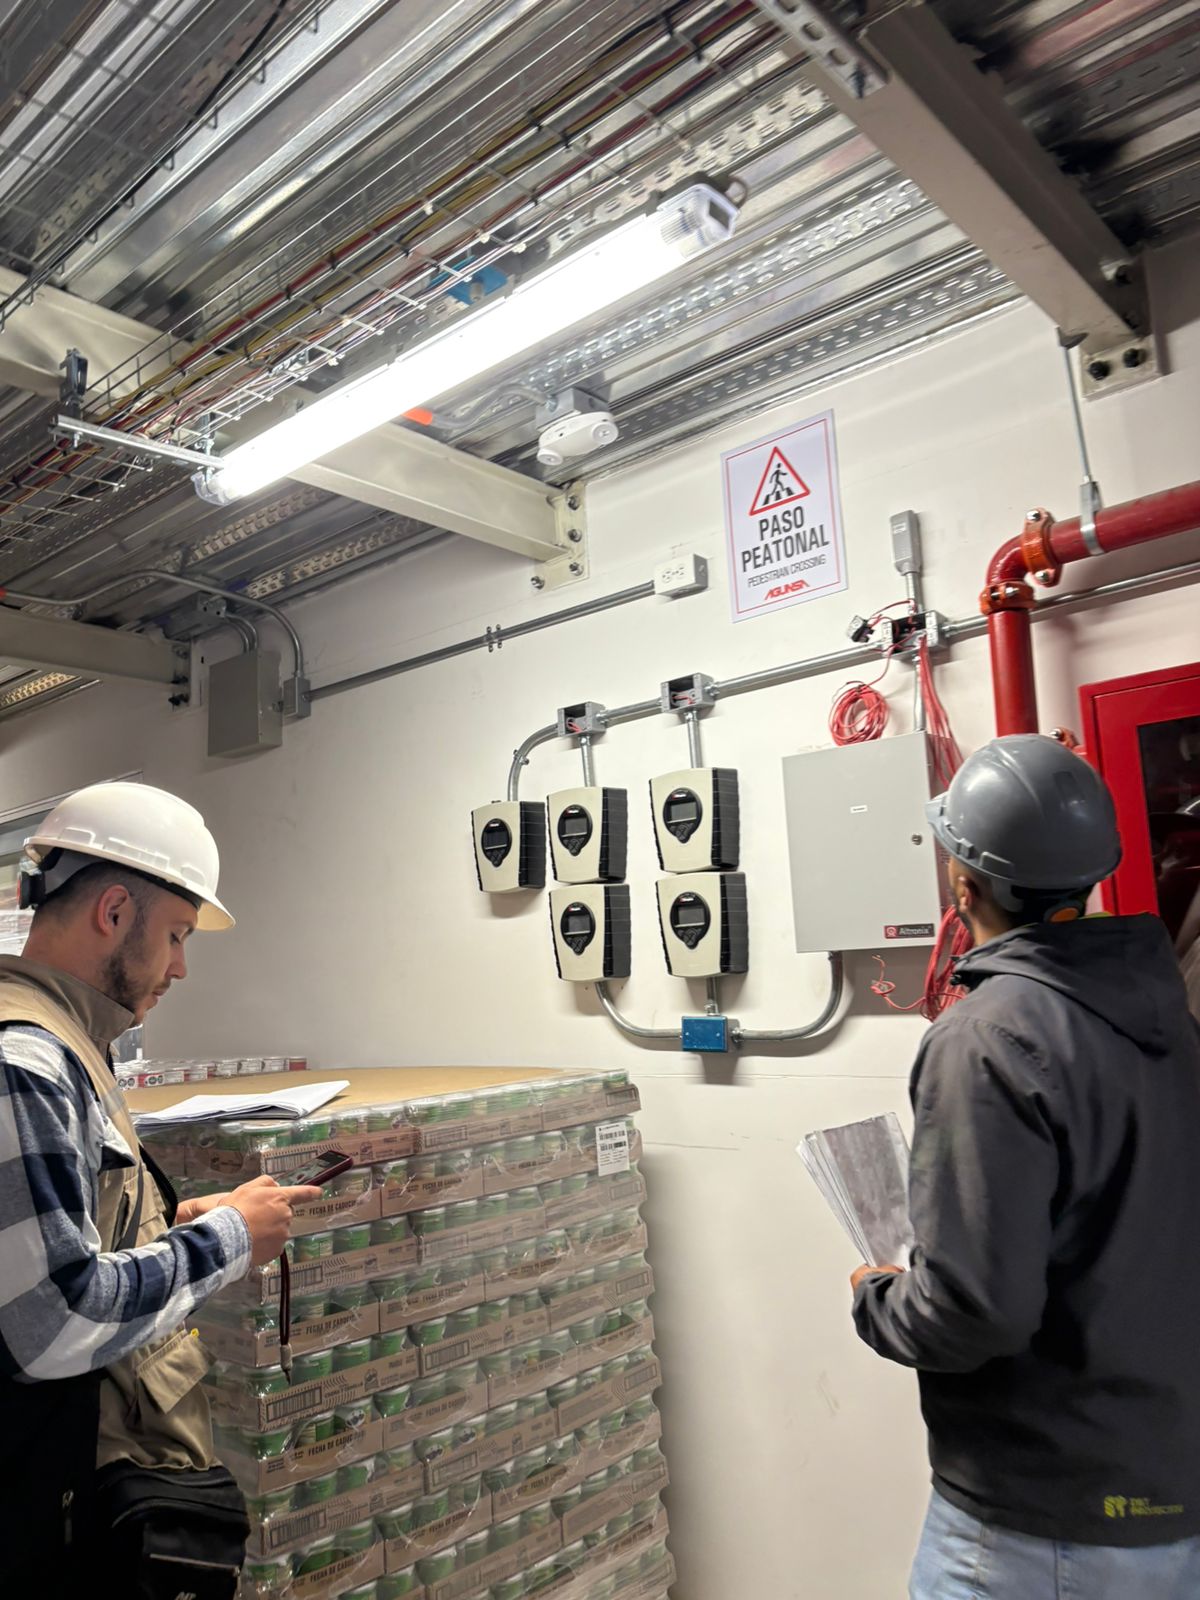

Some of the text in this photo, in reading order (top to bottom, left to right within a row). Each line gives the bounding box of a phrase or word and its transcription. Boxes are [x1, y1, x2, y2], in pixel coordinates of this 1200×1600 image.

[759, 506, 804, 541] PASO
[741, 525, 829, 572] PEATONAL
[748, 554, 826, 587] PEDESTRIAN CROSSING
[764, 579, 810, 600] AGUNSA
